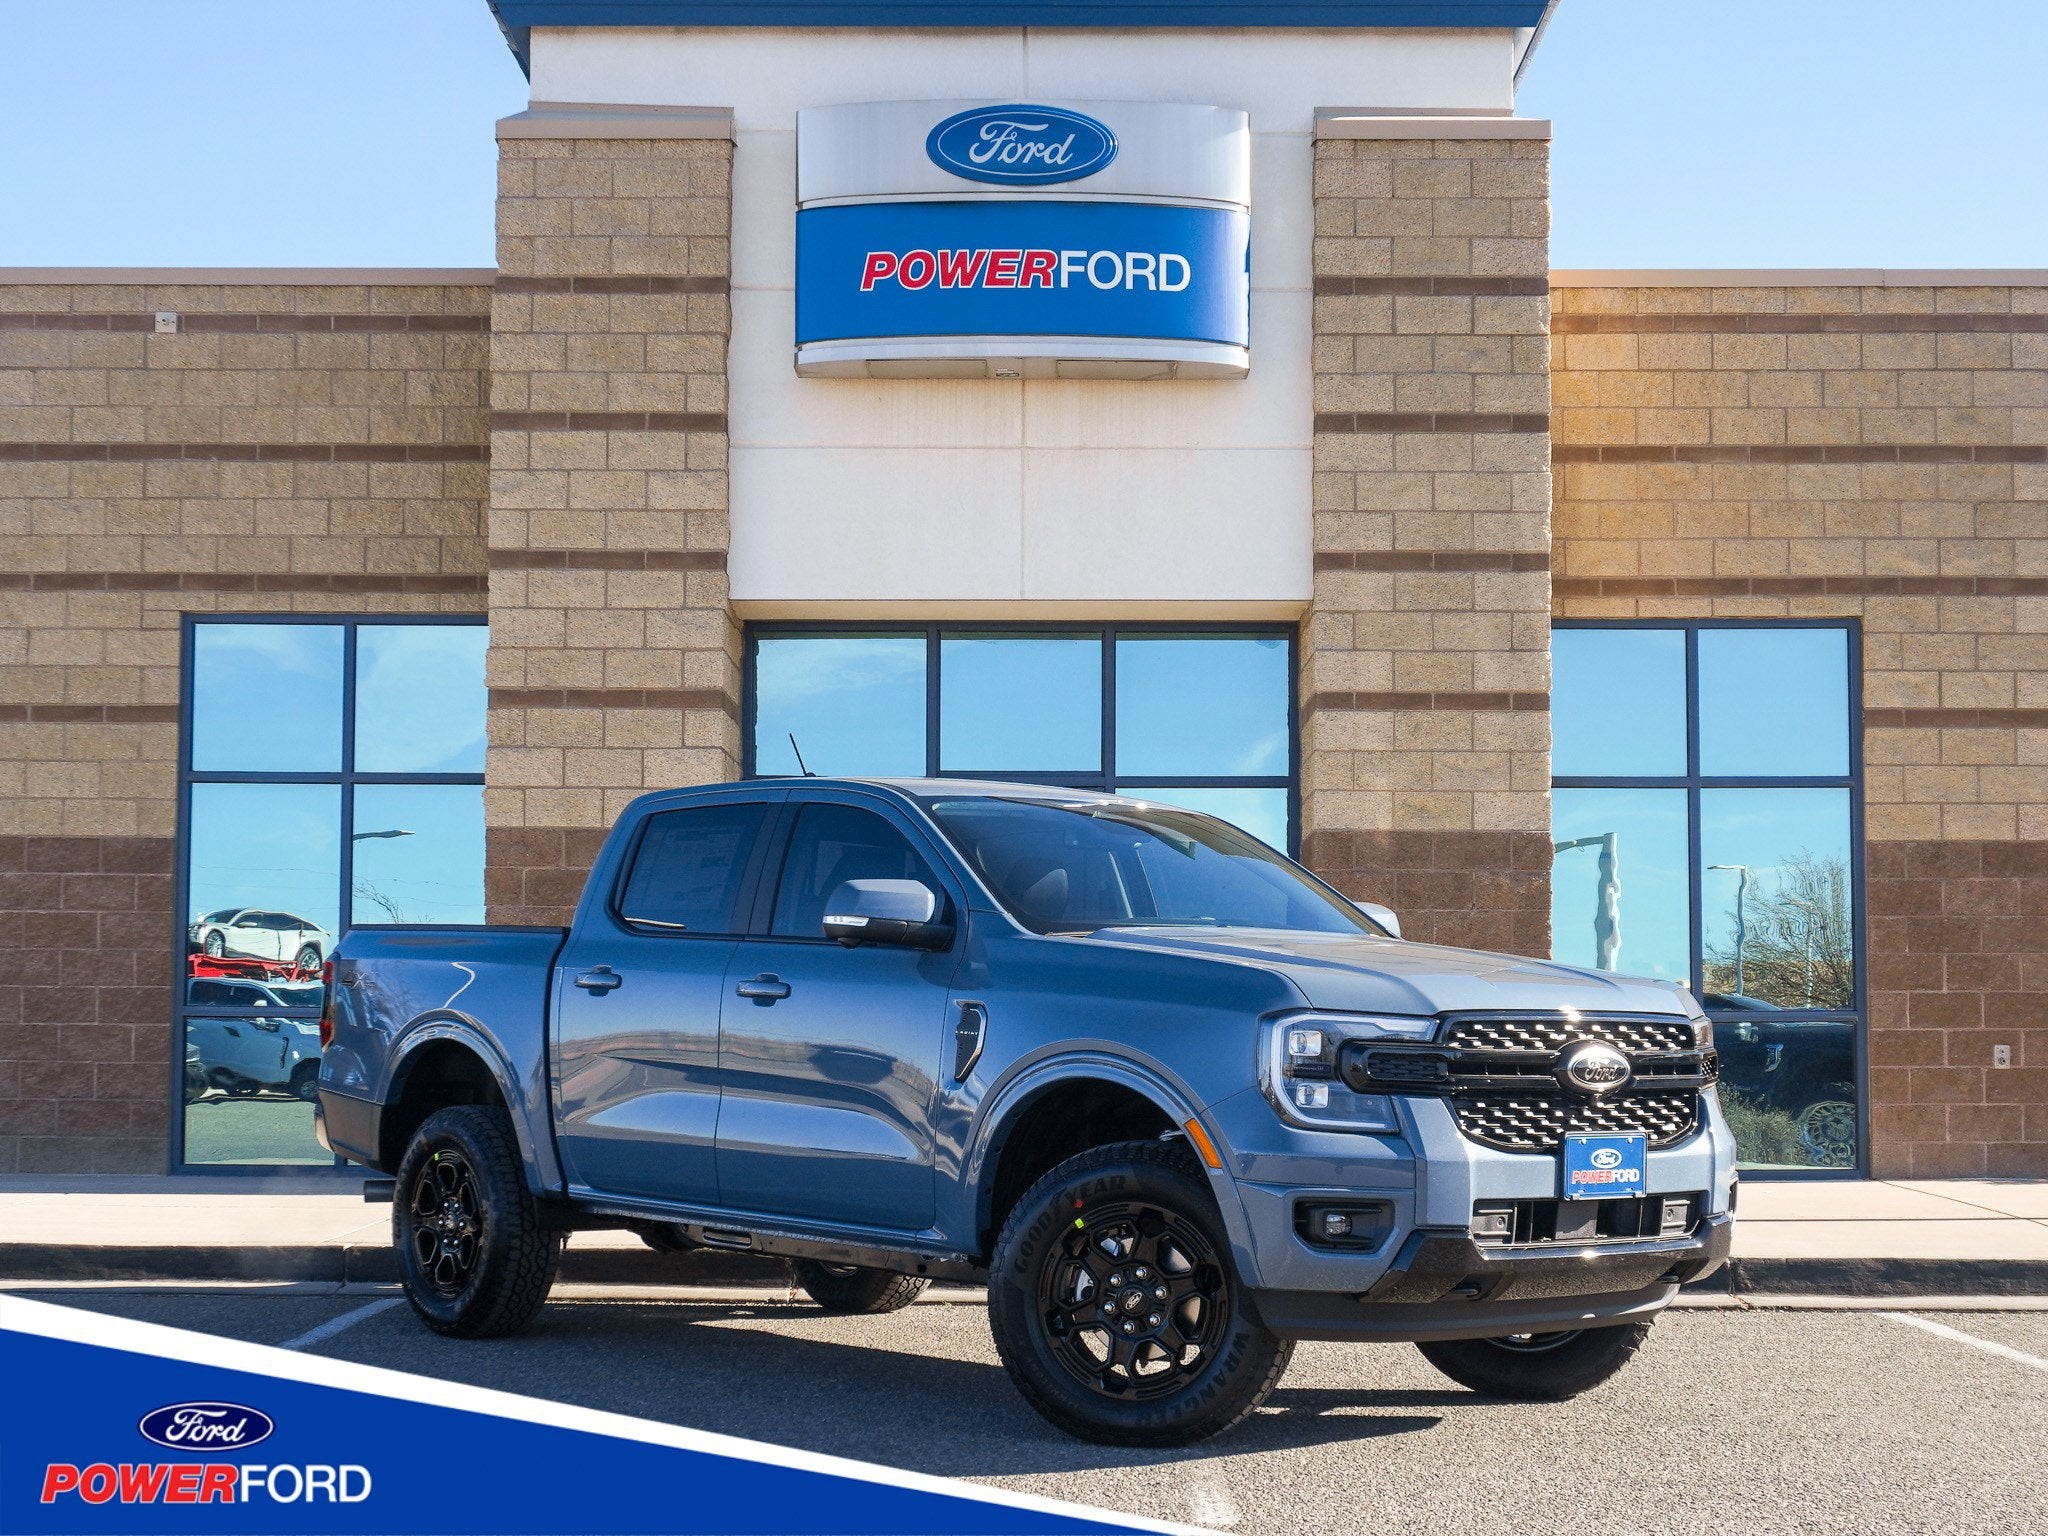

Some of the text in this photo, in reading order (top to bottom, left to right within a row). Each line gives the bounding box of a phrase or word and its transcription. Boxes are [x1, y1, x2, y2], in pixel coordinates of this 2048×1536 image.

[968, 120, 1075, 165] Ford
[860, 248, 1191, 292] POWERFORD
[1584, 1057, 1621, 1082] Ford
[1571, 1169, 1640, 1184] POWERFORD
